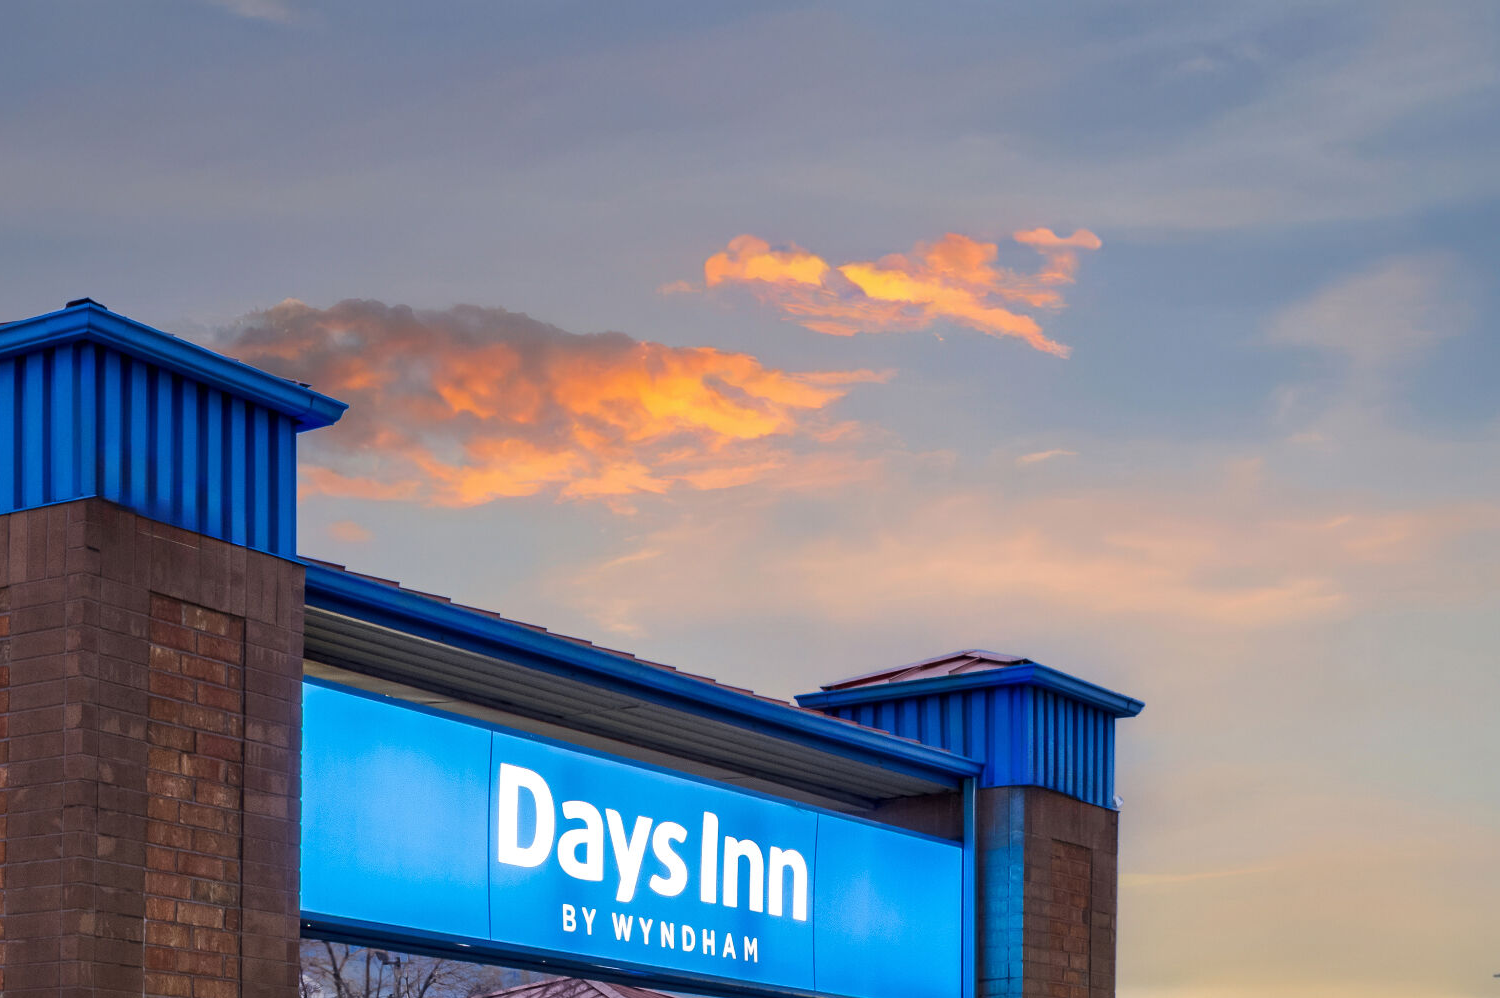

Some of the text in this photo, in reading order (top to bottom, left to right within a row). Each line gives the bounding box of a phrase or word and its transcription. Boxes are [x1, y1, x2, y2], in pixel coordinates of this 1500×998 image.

[497, 762, 808, 922] Days Inn
[562, 903, 758, 963] BY WYNDHAM
